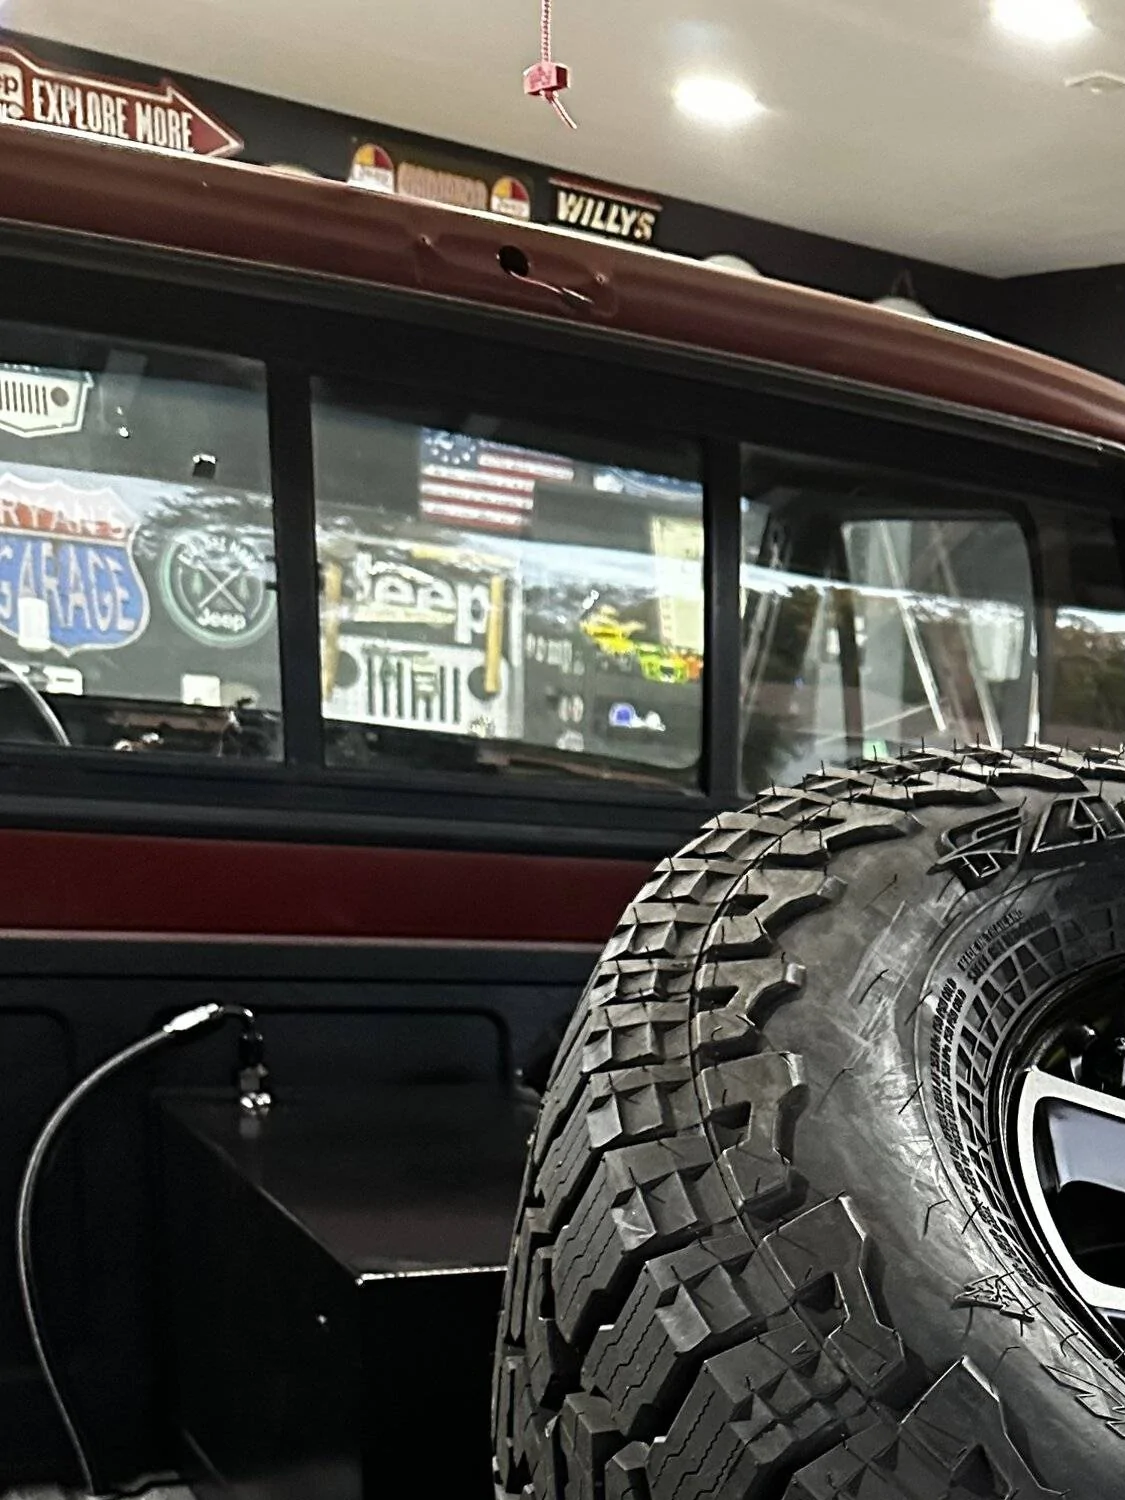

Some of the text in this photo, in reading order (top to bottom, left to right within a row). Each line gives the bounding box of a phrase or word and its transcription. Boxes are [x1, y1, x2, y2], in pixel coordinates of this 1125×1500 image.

[32, 77, 195, 153] EXPLORE MORE
[196, 607, 246, 632] Jeep
[353, 551, 490, 644] Jeep
